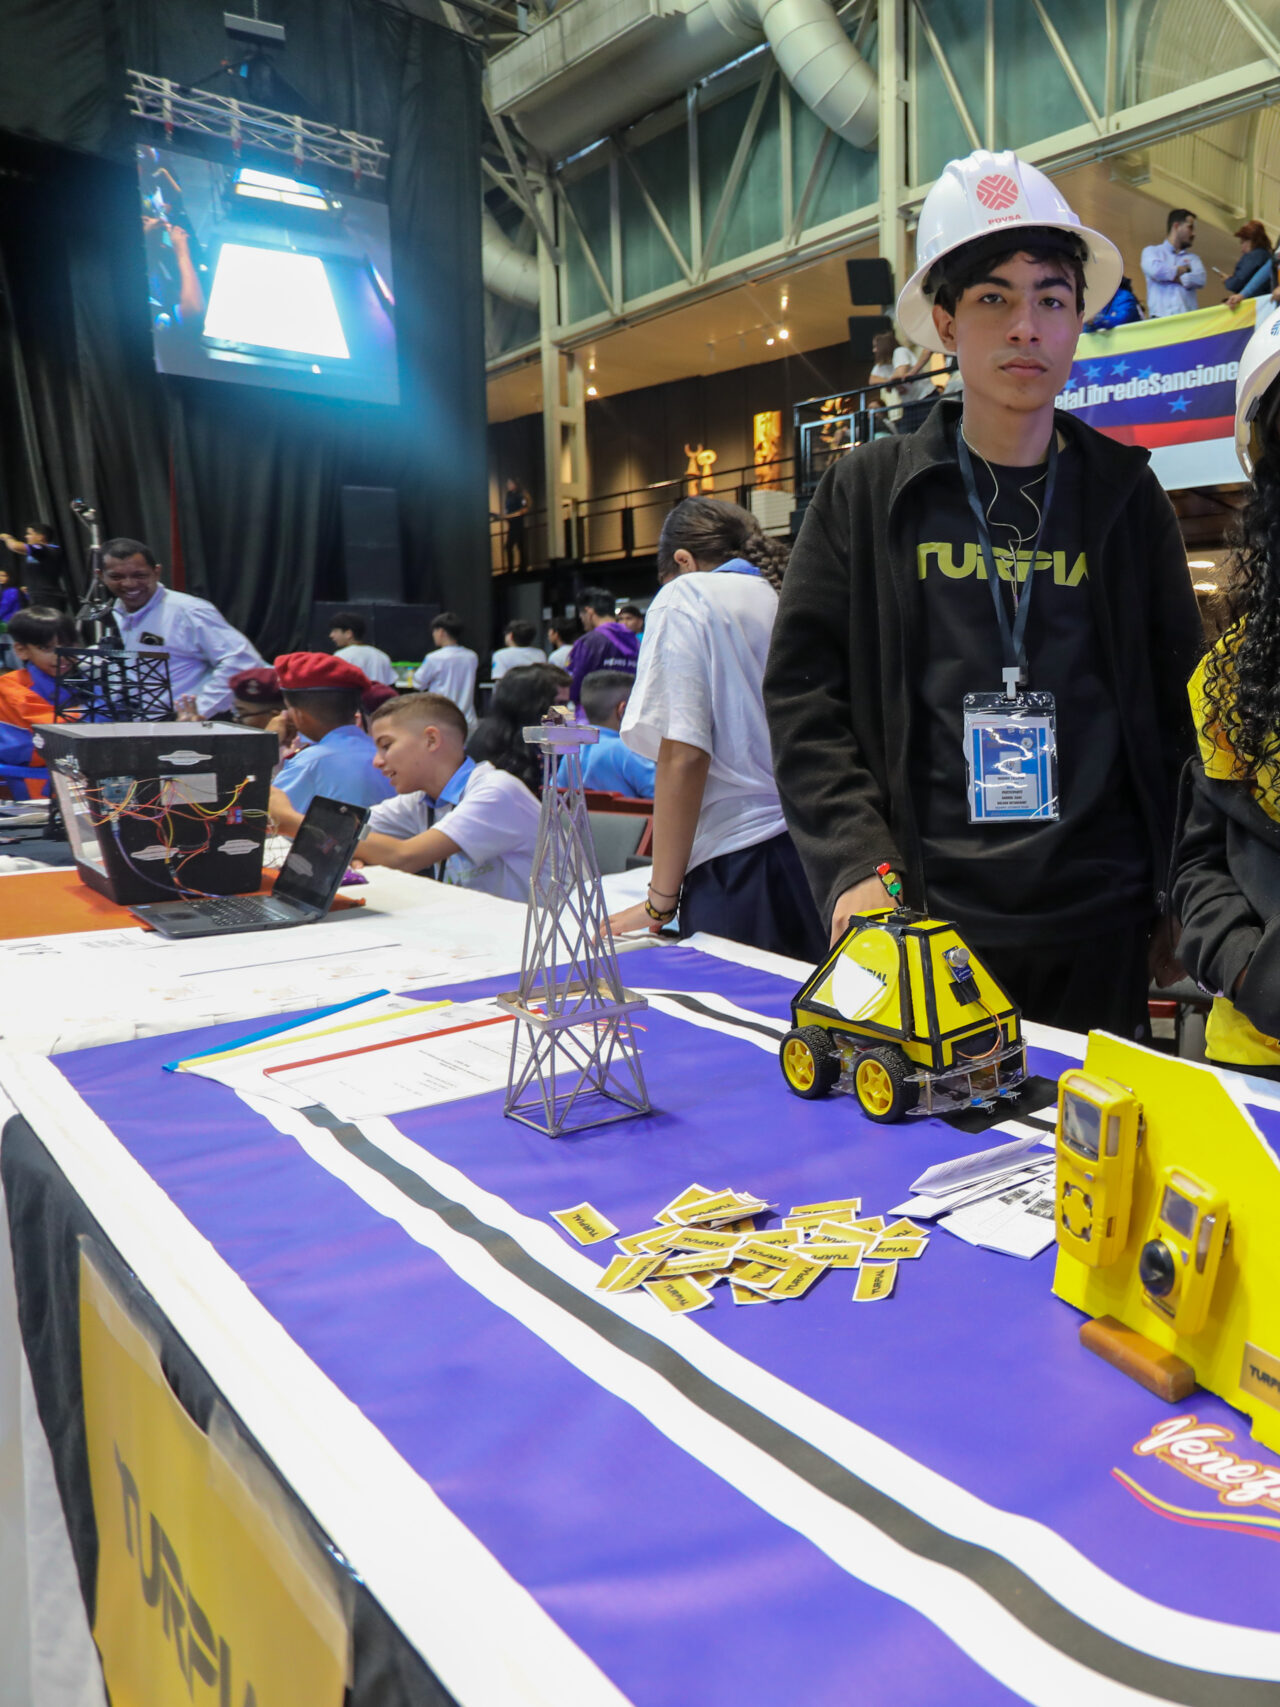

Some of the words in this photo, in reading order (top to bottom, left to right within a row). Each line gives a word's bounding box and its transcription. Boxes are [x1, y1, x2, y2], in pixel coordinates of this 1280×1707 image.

[988, 214, 1022, 225] PDVSA
[683, 1237, 726, 1248] TURPIAL
[748, 1248, 789, 1264] TURPIAL
[784, 1266, 815, 1291] TURPIAL
[664, 1283, 689, 1307] TURPIAL
[113, 1438, 259, 1707] TURPI
